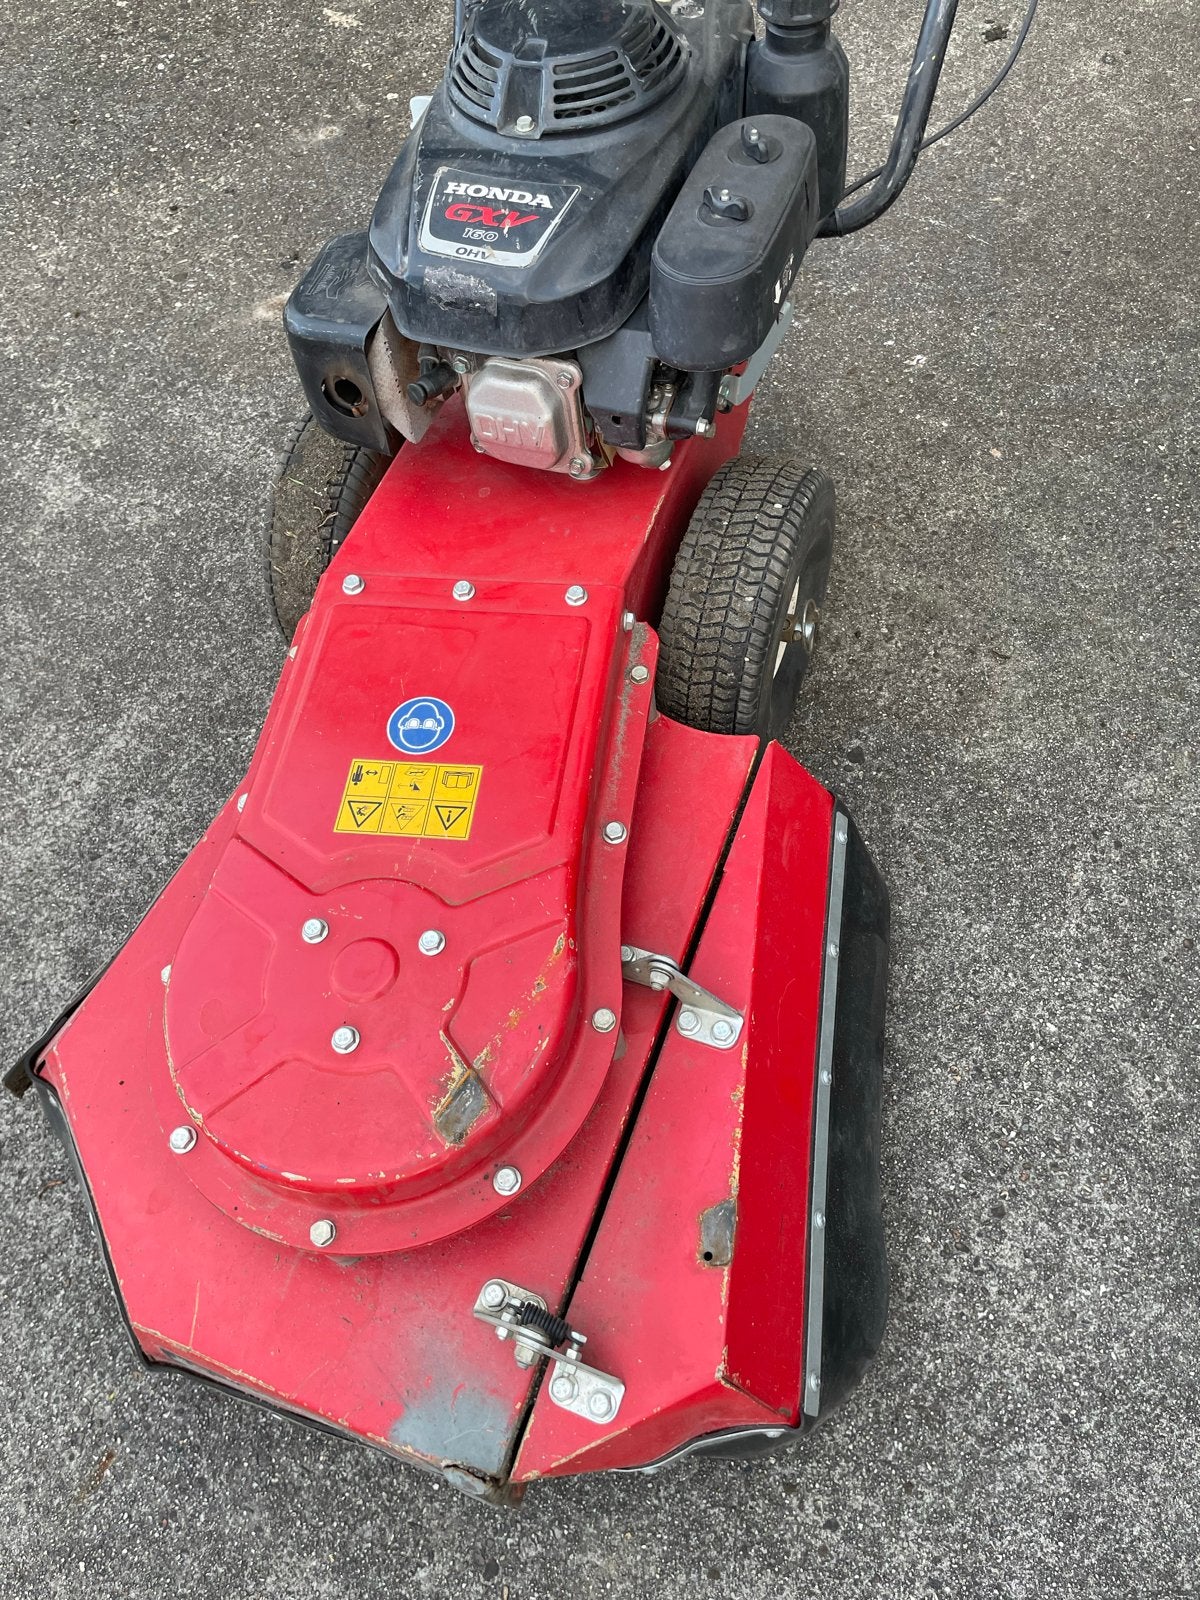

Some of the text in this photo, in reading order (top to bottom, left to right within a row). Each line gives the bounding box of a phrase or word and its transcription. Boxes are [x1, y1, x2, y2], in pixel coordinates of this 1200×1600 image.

[444, 182, 553, 209] HONDA
[445, 203, 540, 228] GXV
[463, 228, 499, 242] 160
[455, 247, 492, 260] OHV
[475, 413, 545, 449] OHV
